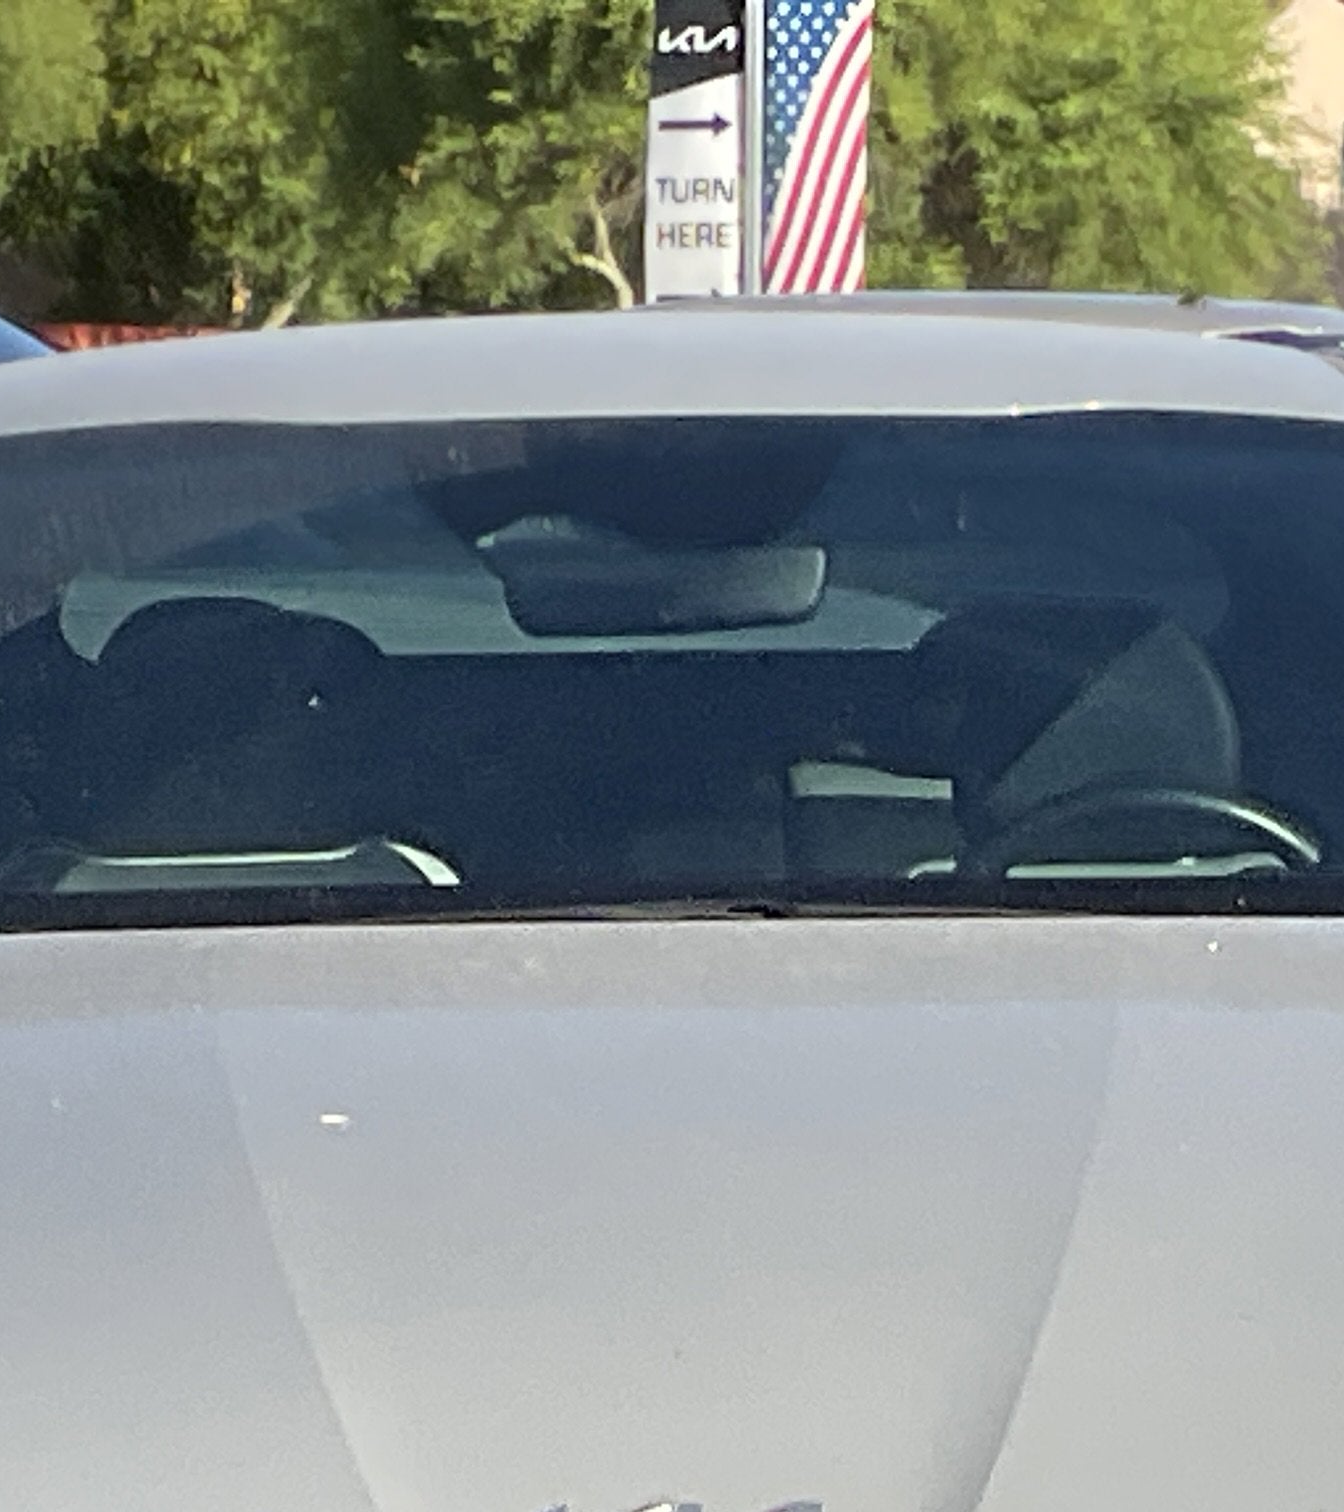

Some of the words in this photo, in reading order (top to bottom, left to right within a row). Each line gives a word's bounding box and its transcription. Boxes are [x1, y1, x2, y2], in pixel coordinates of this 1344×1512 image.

[658, 25, 737, 52] KIA
[656, 178, 734, 203] TURN
[657, 223, 732, 249] HERE
